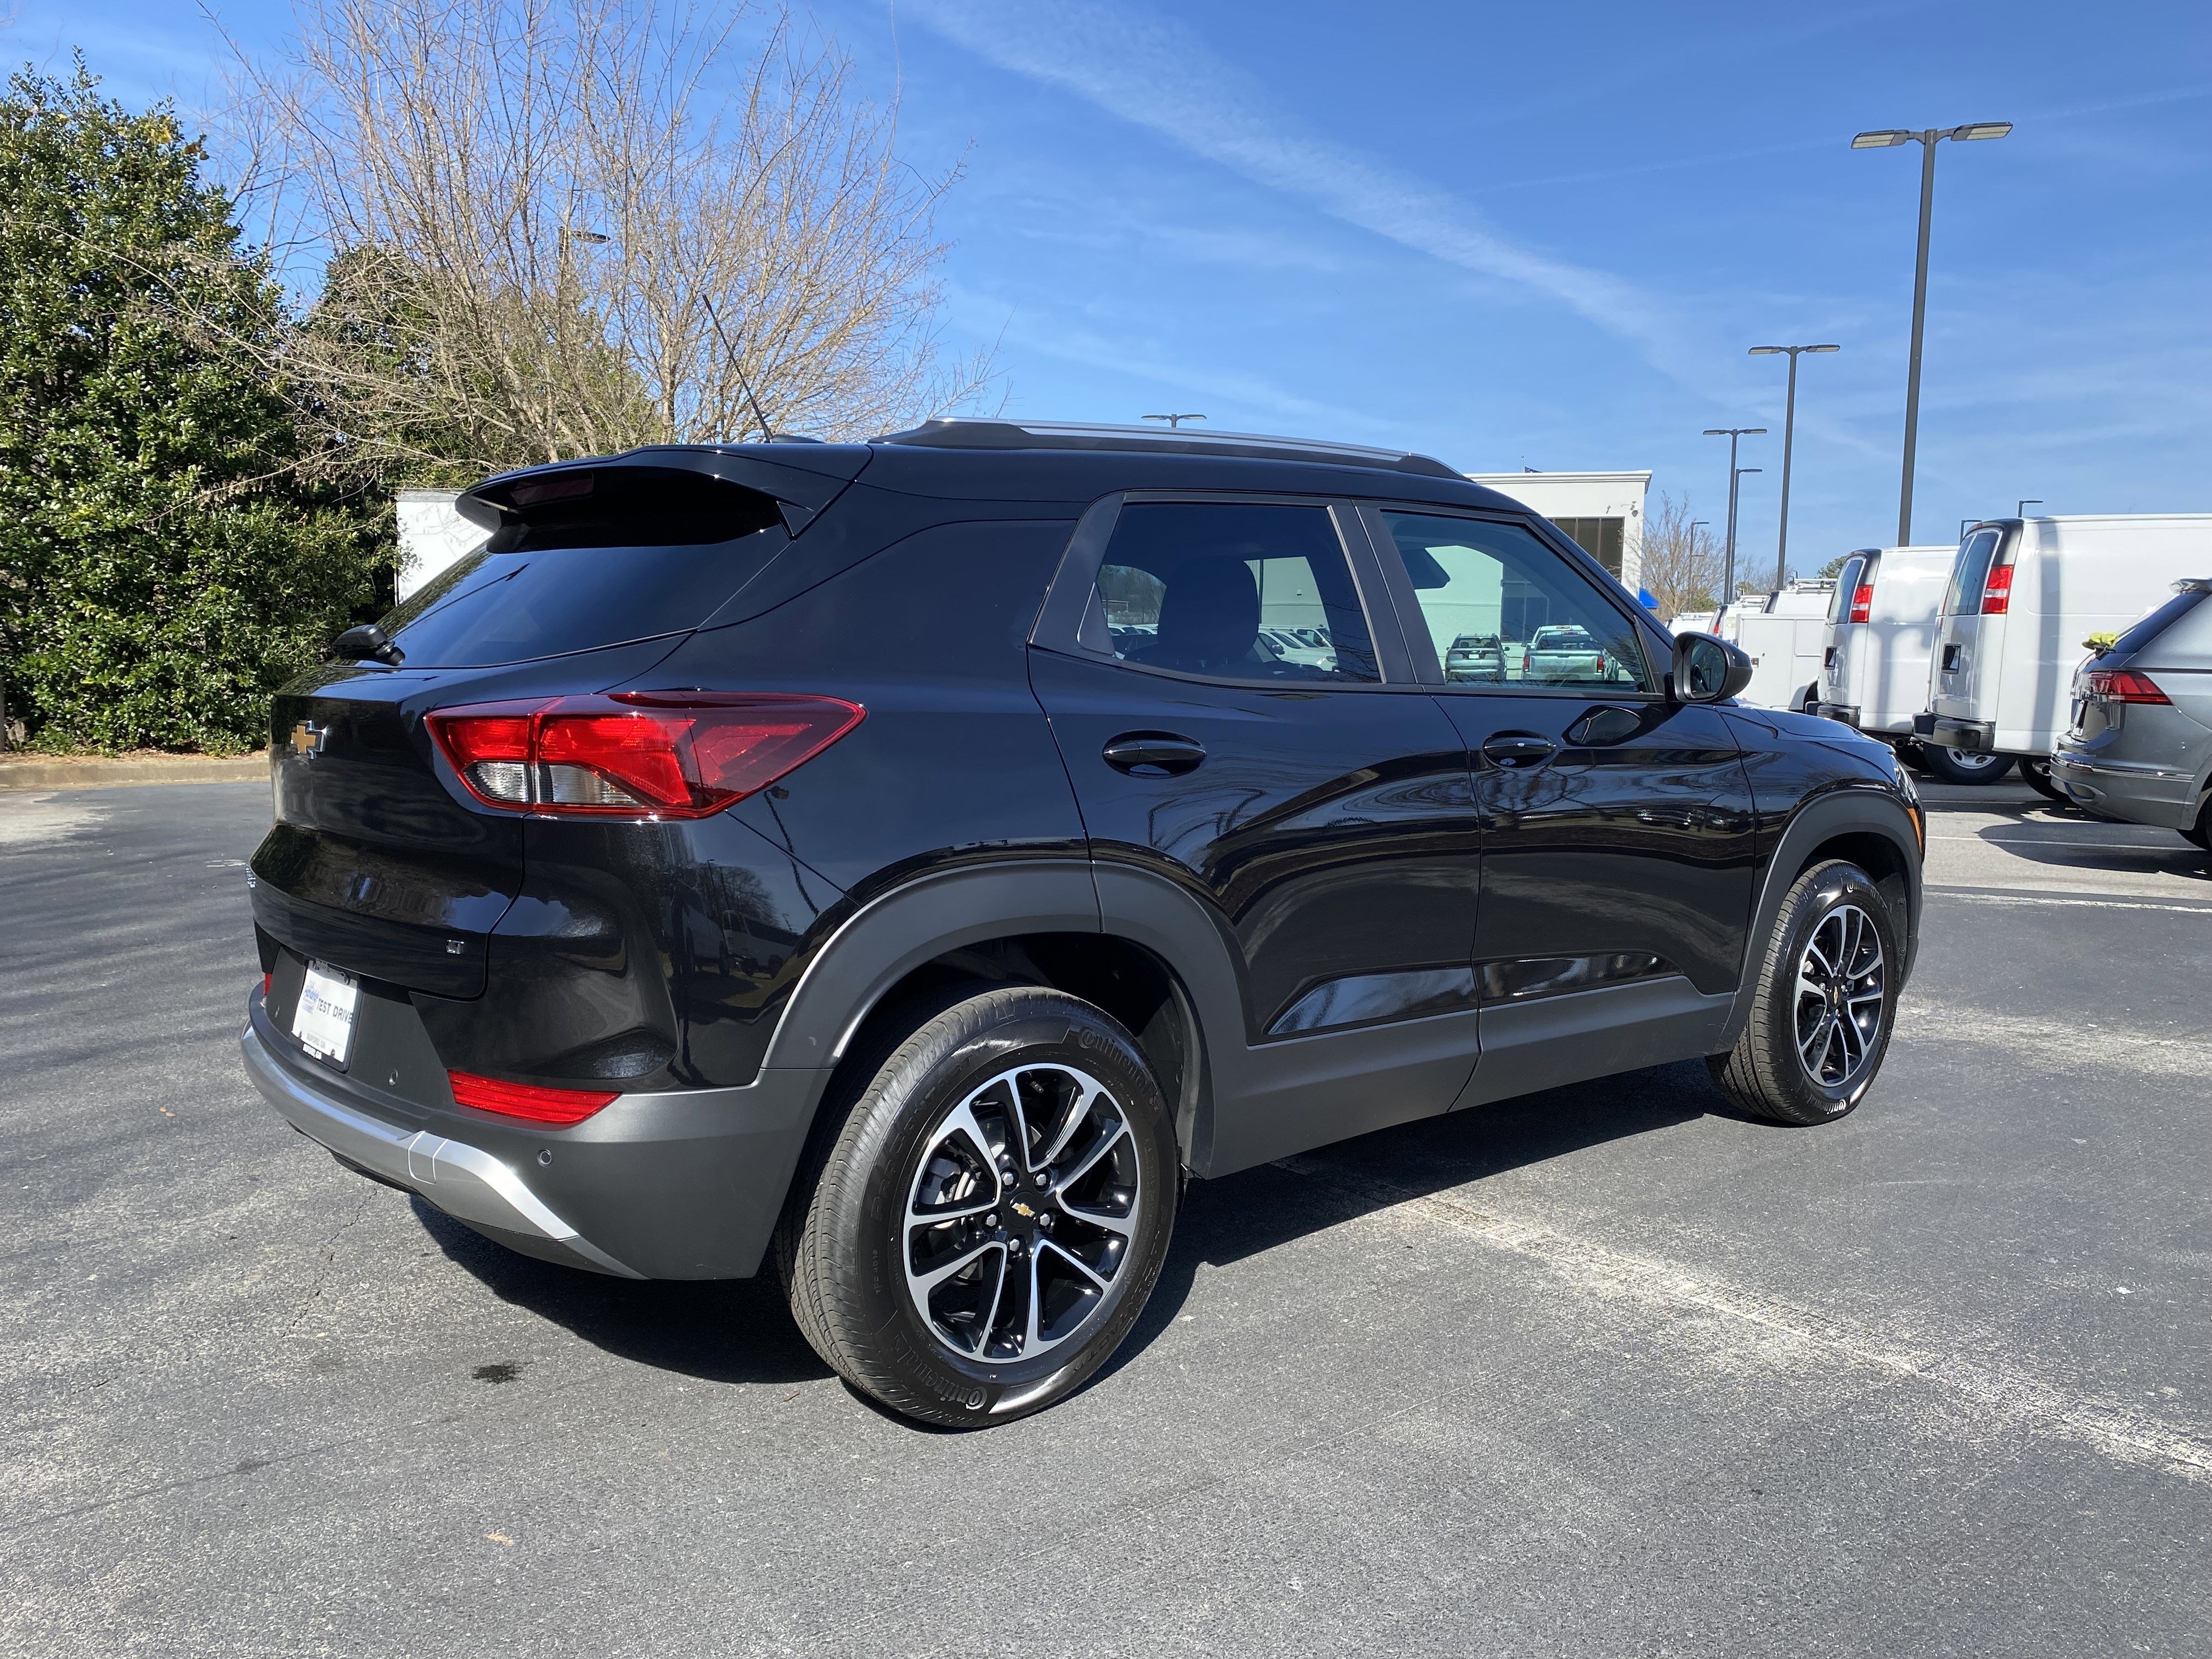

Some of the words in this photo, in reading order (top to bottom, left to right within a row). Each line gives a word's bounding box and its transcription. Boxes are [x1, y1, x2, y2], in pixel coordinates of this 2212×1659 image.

[317, 997, 331, 1015] TEST
[332, 1005, 353, 1025] DRIVE
[897, 1345, 988, 1410] Continental
